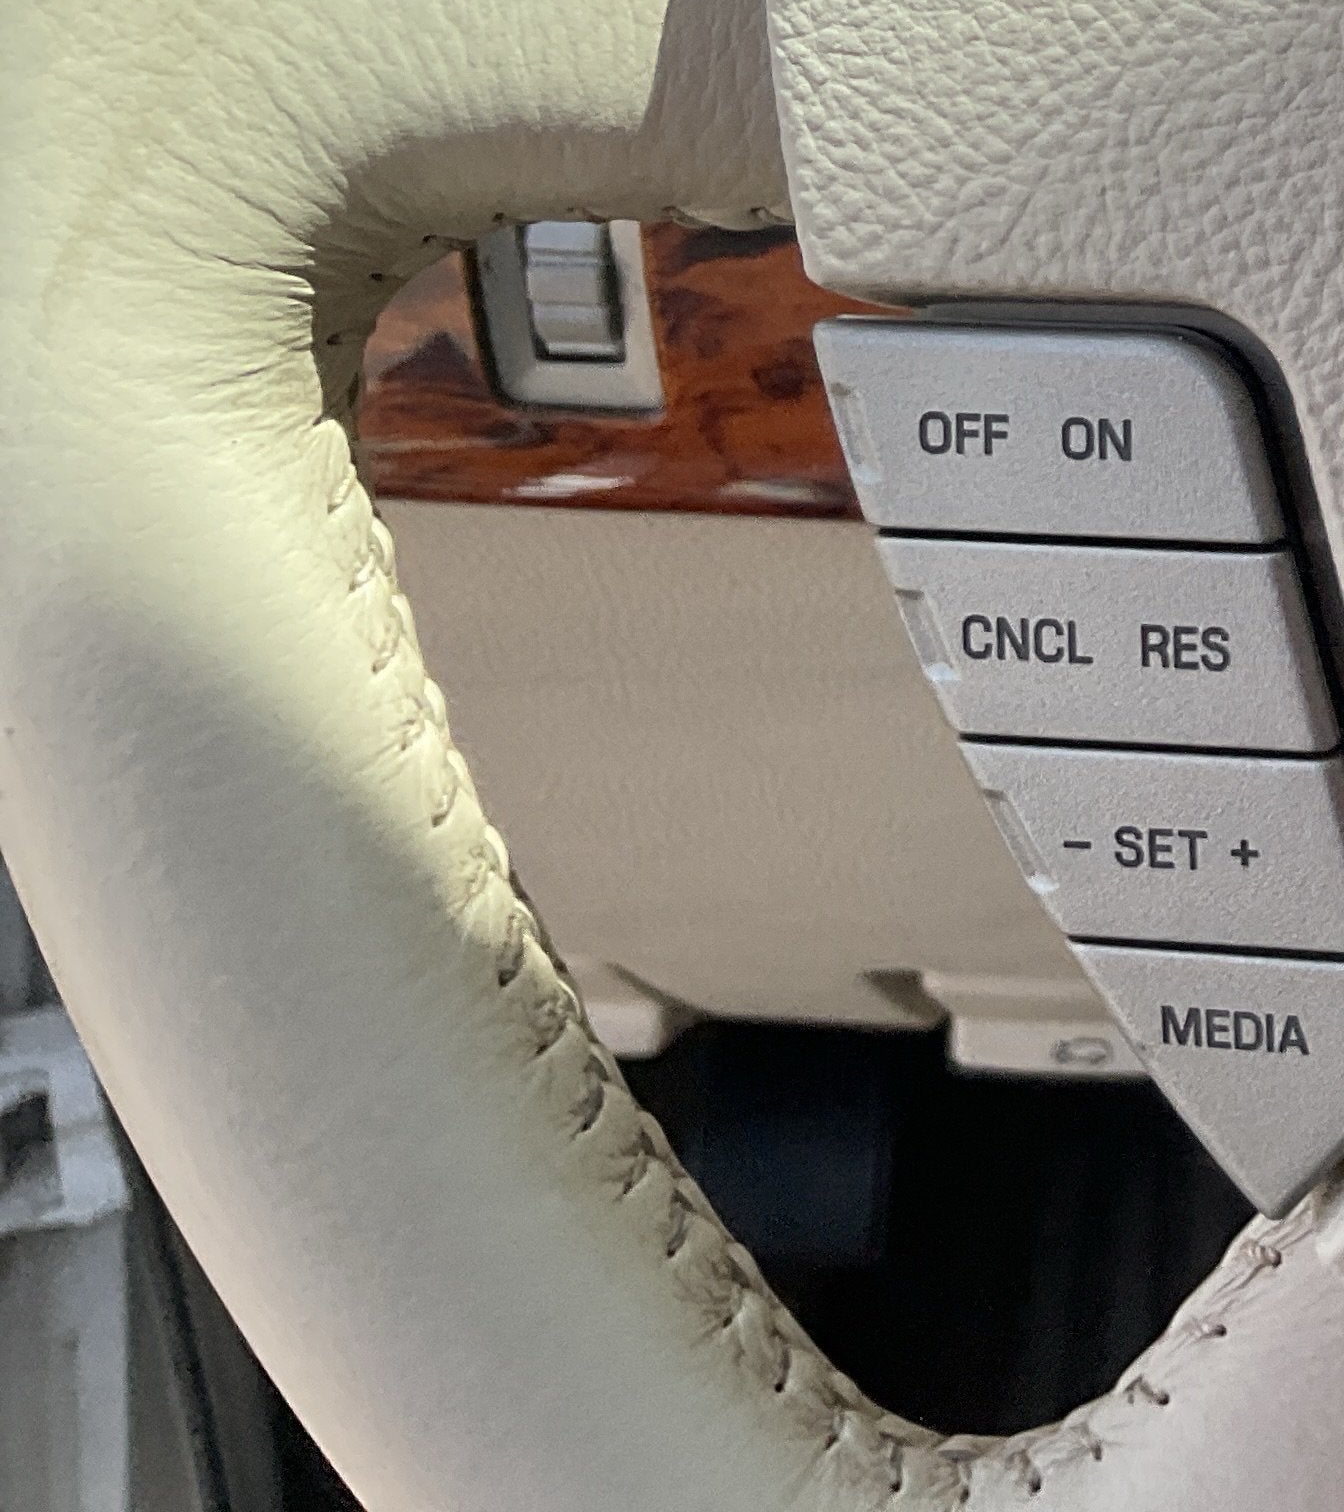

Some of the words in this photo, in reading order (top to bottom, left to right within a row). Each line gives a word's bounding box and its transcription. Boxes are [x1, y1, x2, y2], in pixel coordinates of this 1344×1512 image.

[918, 412, 1010, 456] OFF
[1061, 418, 1133, 462] ON
[961, 615, 1093, 666] CNCL
[1140, 625, 1231, 671] RES
[1114, 827, 1208, 870] SET
[1160, 1005, 1310, 1056] MEDIA
